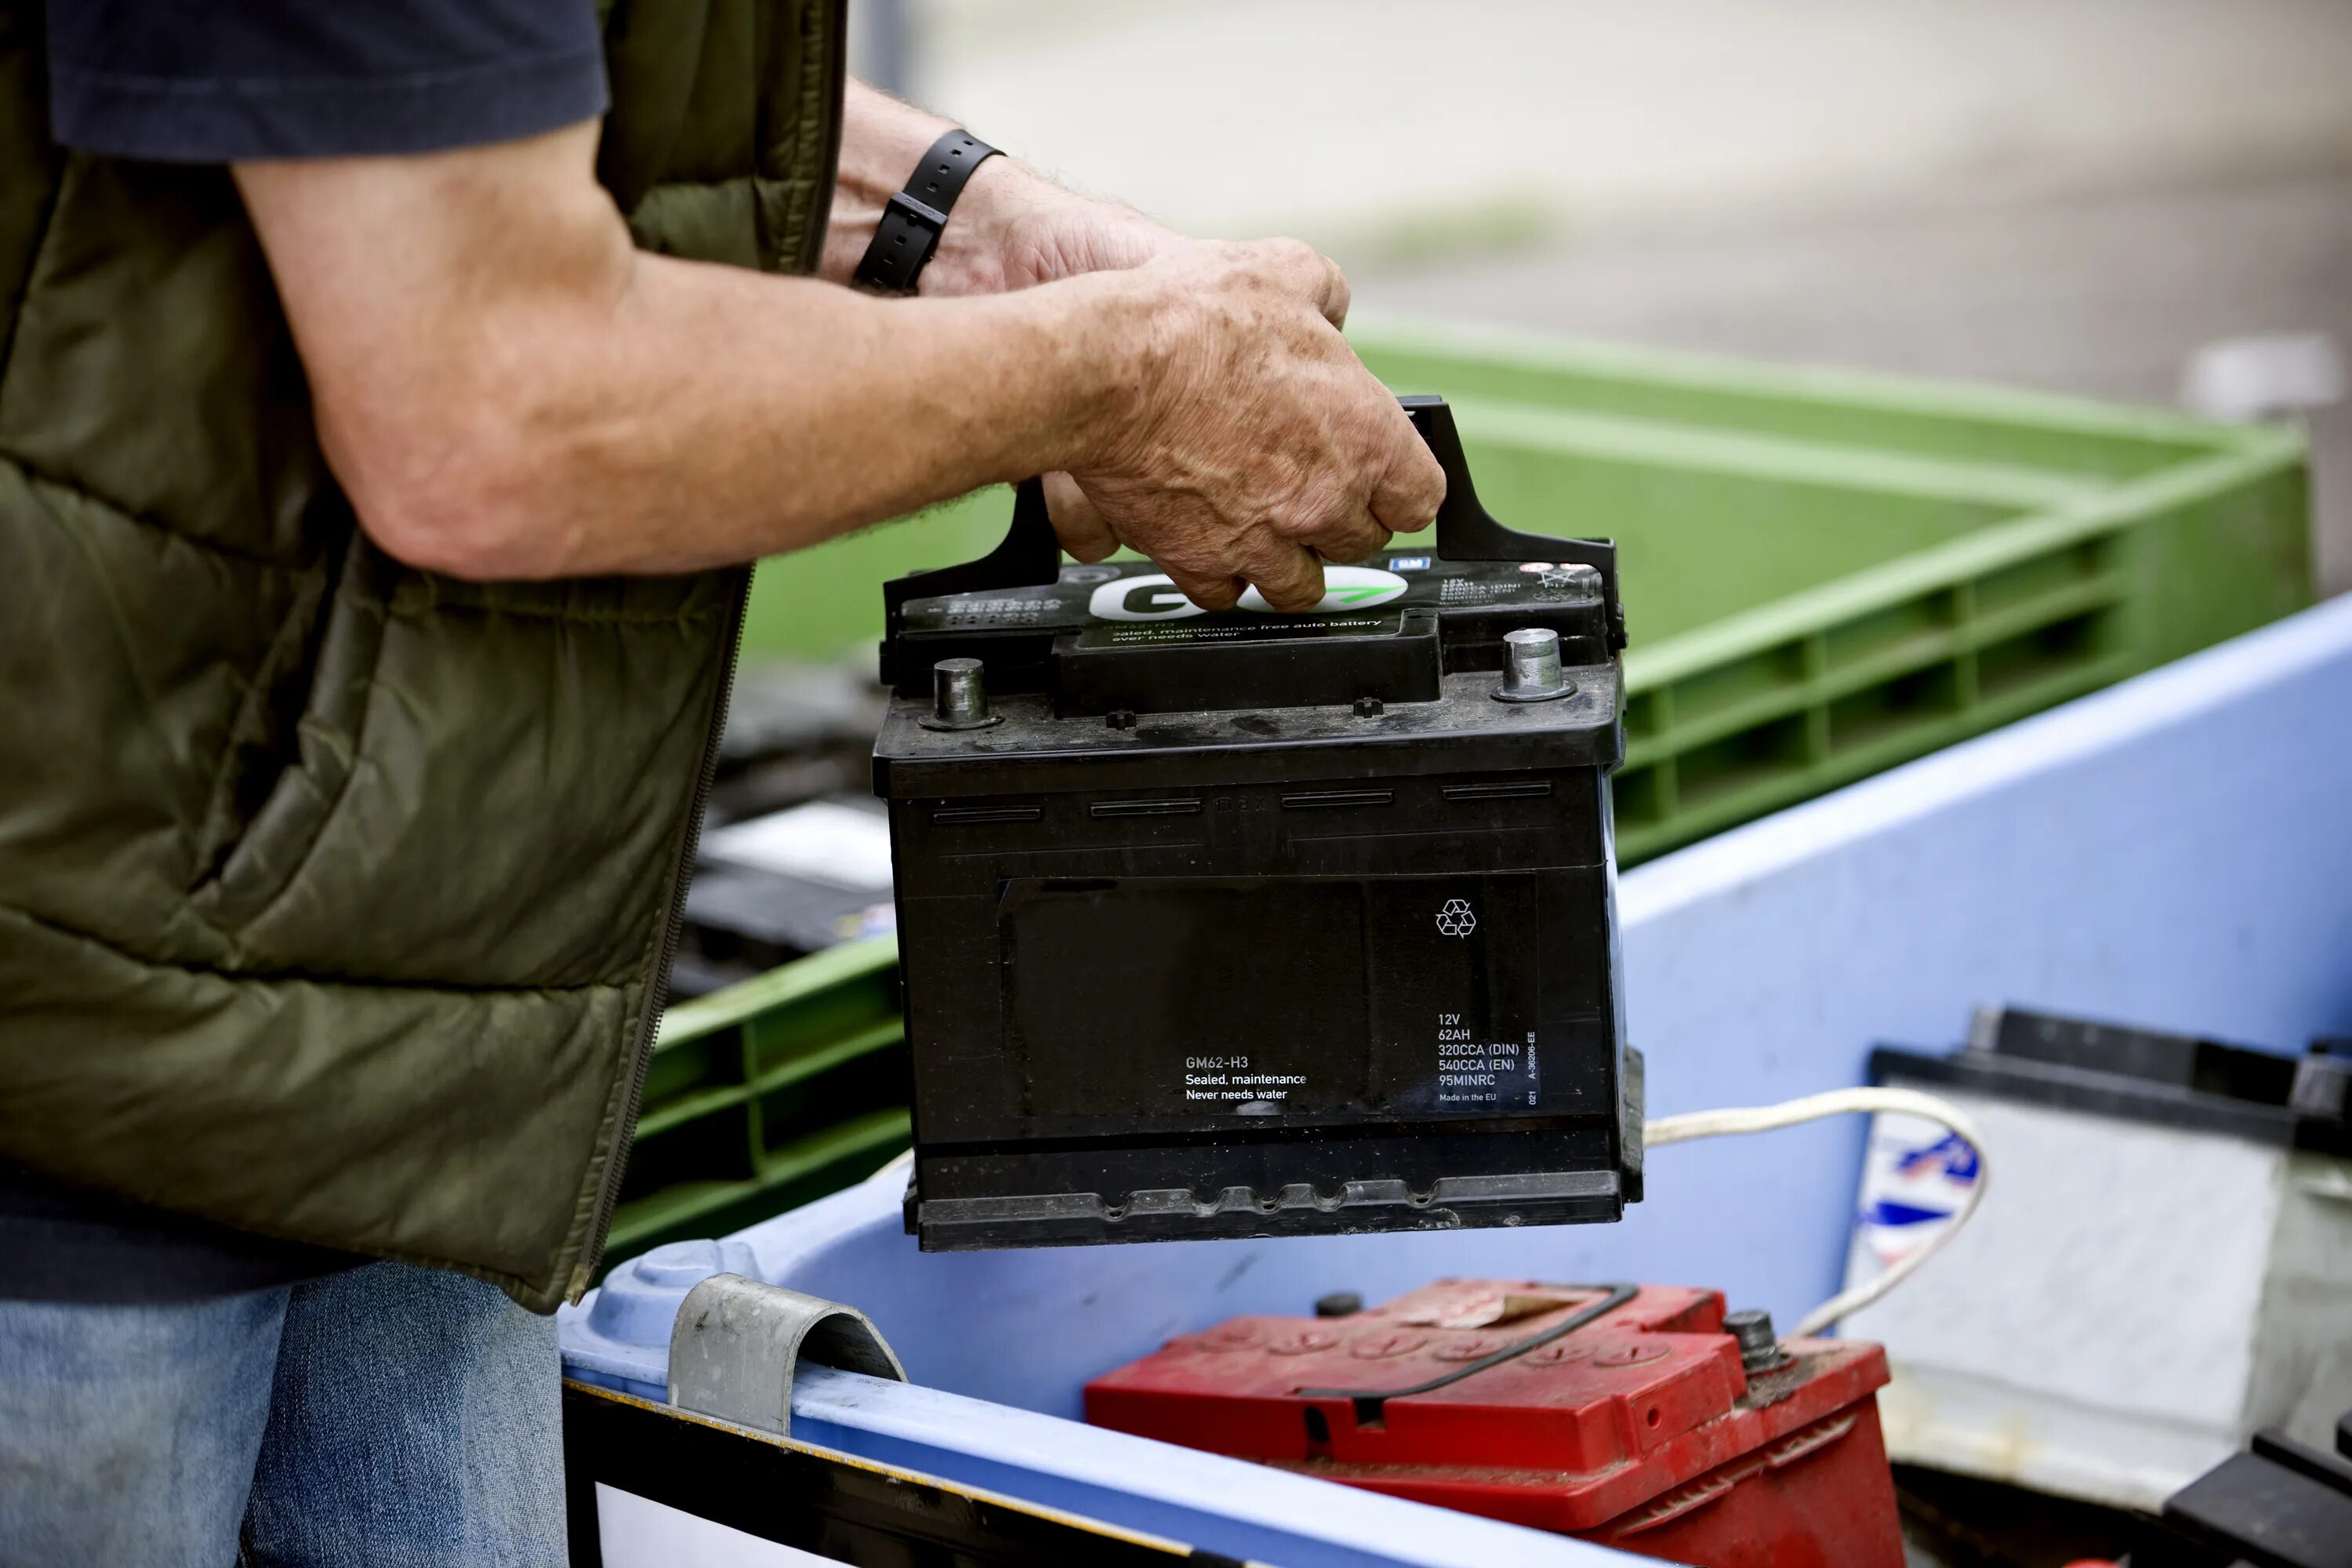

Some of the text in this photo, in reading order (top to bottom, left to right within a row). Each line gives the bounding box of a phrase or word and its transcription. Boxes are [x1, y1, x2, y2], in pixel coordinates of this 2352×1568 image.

[1439, 1014, 1461, 1025] 12V
[1438, 1029, 1471, 1040] 62AH
[1438, 1044, 1519, 1056] 320CCA (DIN)
[1185, 1056, 1249, 1069] GM62-H3
[1439, 1058, 1515, 1072] 540CCA (EN)
[1527, 1031, 1537, 1105] 021 A-36206-EE
[1185, 1073, 1307, 1086] Sealed, maintenance
[1439, 1074, 1496, 1086] 95MINRC
[1186, 1089, 1287, 1100] Never needs water
